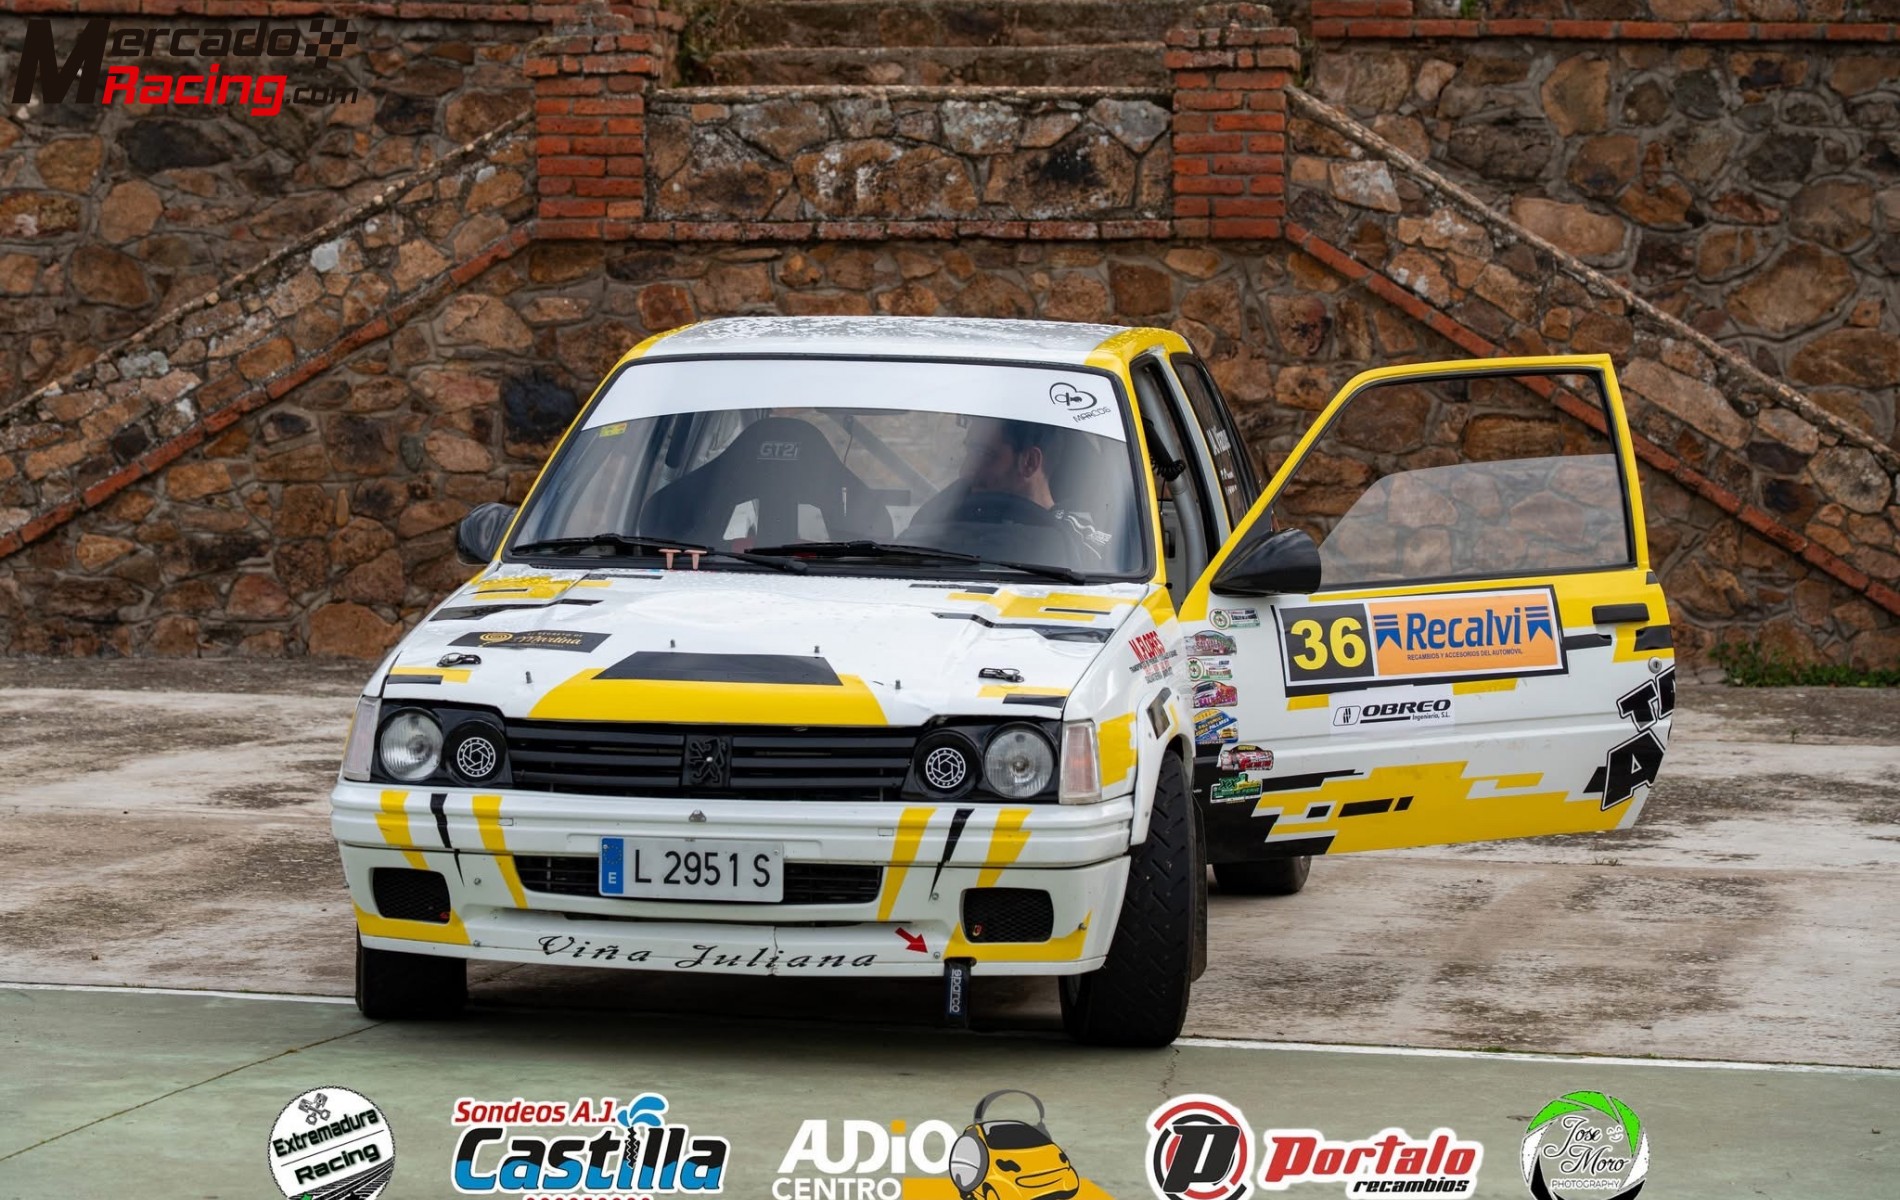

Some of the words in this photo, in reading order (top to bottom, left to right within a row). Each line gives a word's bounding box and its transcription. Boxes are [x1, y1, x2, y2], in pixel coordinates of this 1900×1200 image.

[1290, 617, 1367, 670] 36
[1406, 607, 1522, 651] Recalvi
[1407, 653, 1440, 661] RECAMBIOS
[1444, 650, 1480, 659] ACCESORIOS
[1362, 699, 1451, 717] OBREO
[608, 872, 617, 885] E
[635, 849, 652, 884] L
[663, 850, 739, 887] 2951
[752, 853, 771, 888] S
[538, 935, 653, 962] Viña
[674, 944, 879, 969] Juliana
